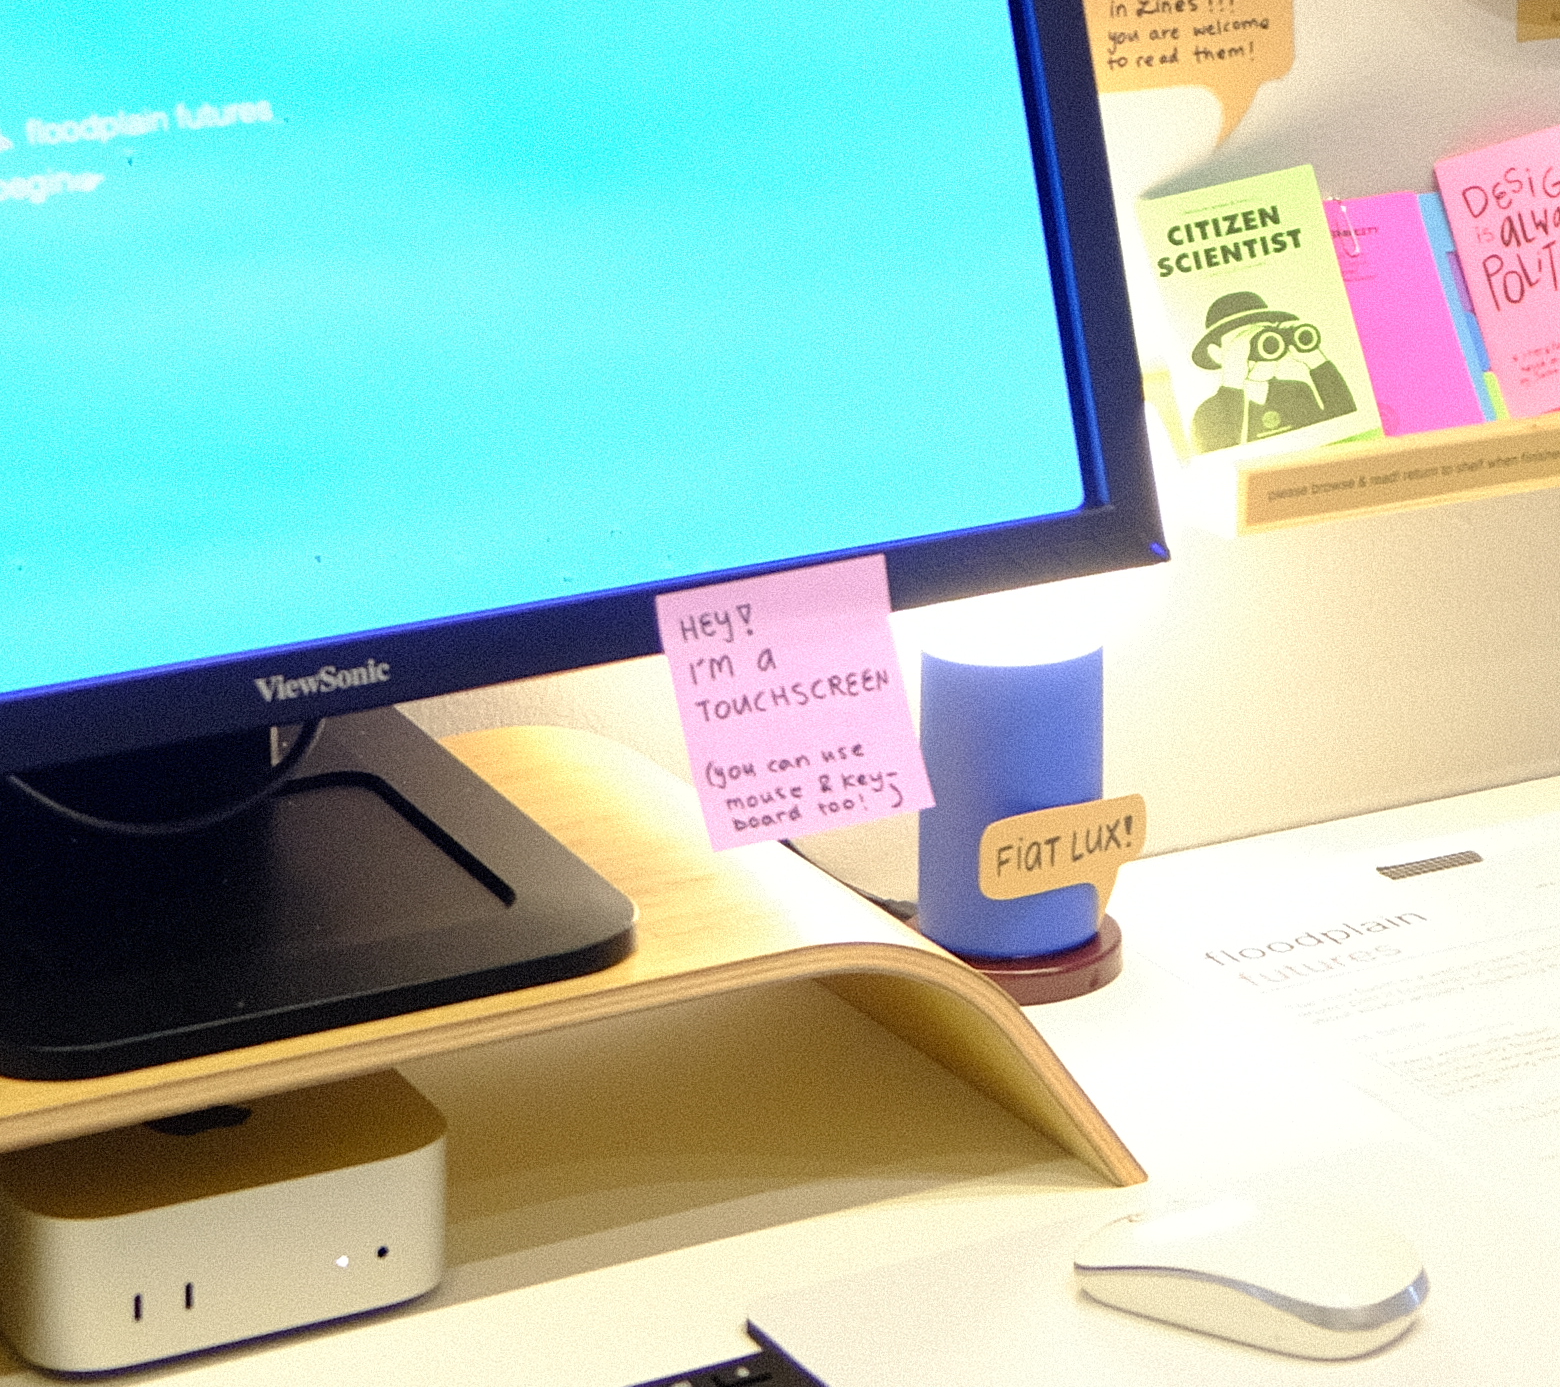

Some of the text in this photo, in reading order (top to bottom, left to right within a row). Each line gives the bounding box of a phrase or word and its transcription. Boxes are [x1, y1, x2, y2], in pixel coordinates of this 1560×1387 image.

[1109, 0, 1128, 19] in
[1107, 17, 1271, 55] you are welcome
[1107, 55, 1129, 71] to
[1135, 46, 1180, 69] read
[1166, 204, 1283, 247] CITIZEN
[1156, 227, 1304, 278] SCIENTIST
[253, 657, 391, 702] ViewSonic
[693, 667, 891, 724] TOUCHSCREEN
[766, 752, 811, 775] can
[821, 742, 865, 765] use
[725, 785, 805, 812] mouse
[733, 801, 803, 835] board
[1070, 813, 1136, 861] LUX!
[1204, 911, 1428, 967] floodplain
[1238, 943, 1402, 987] futures
